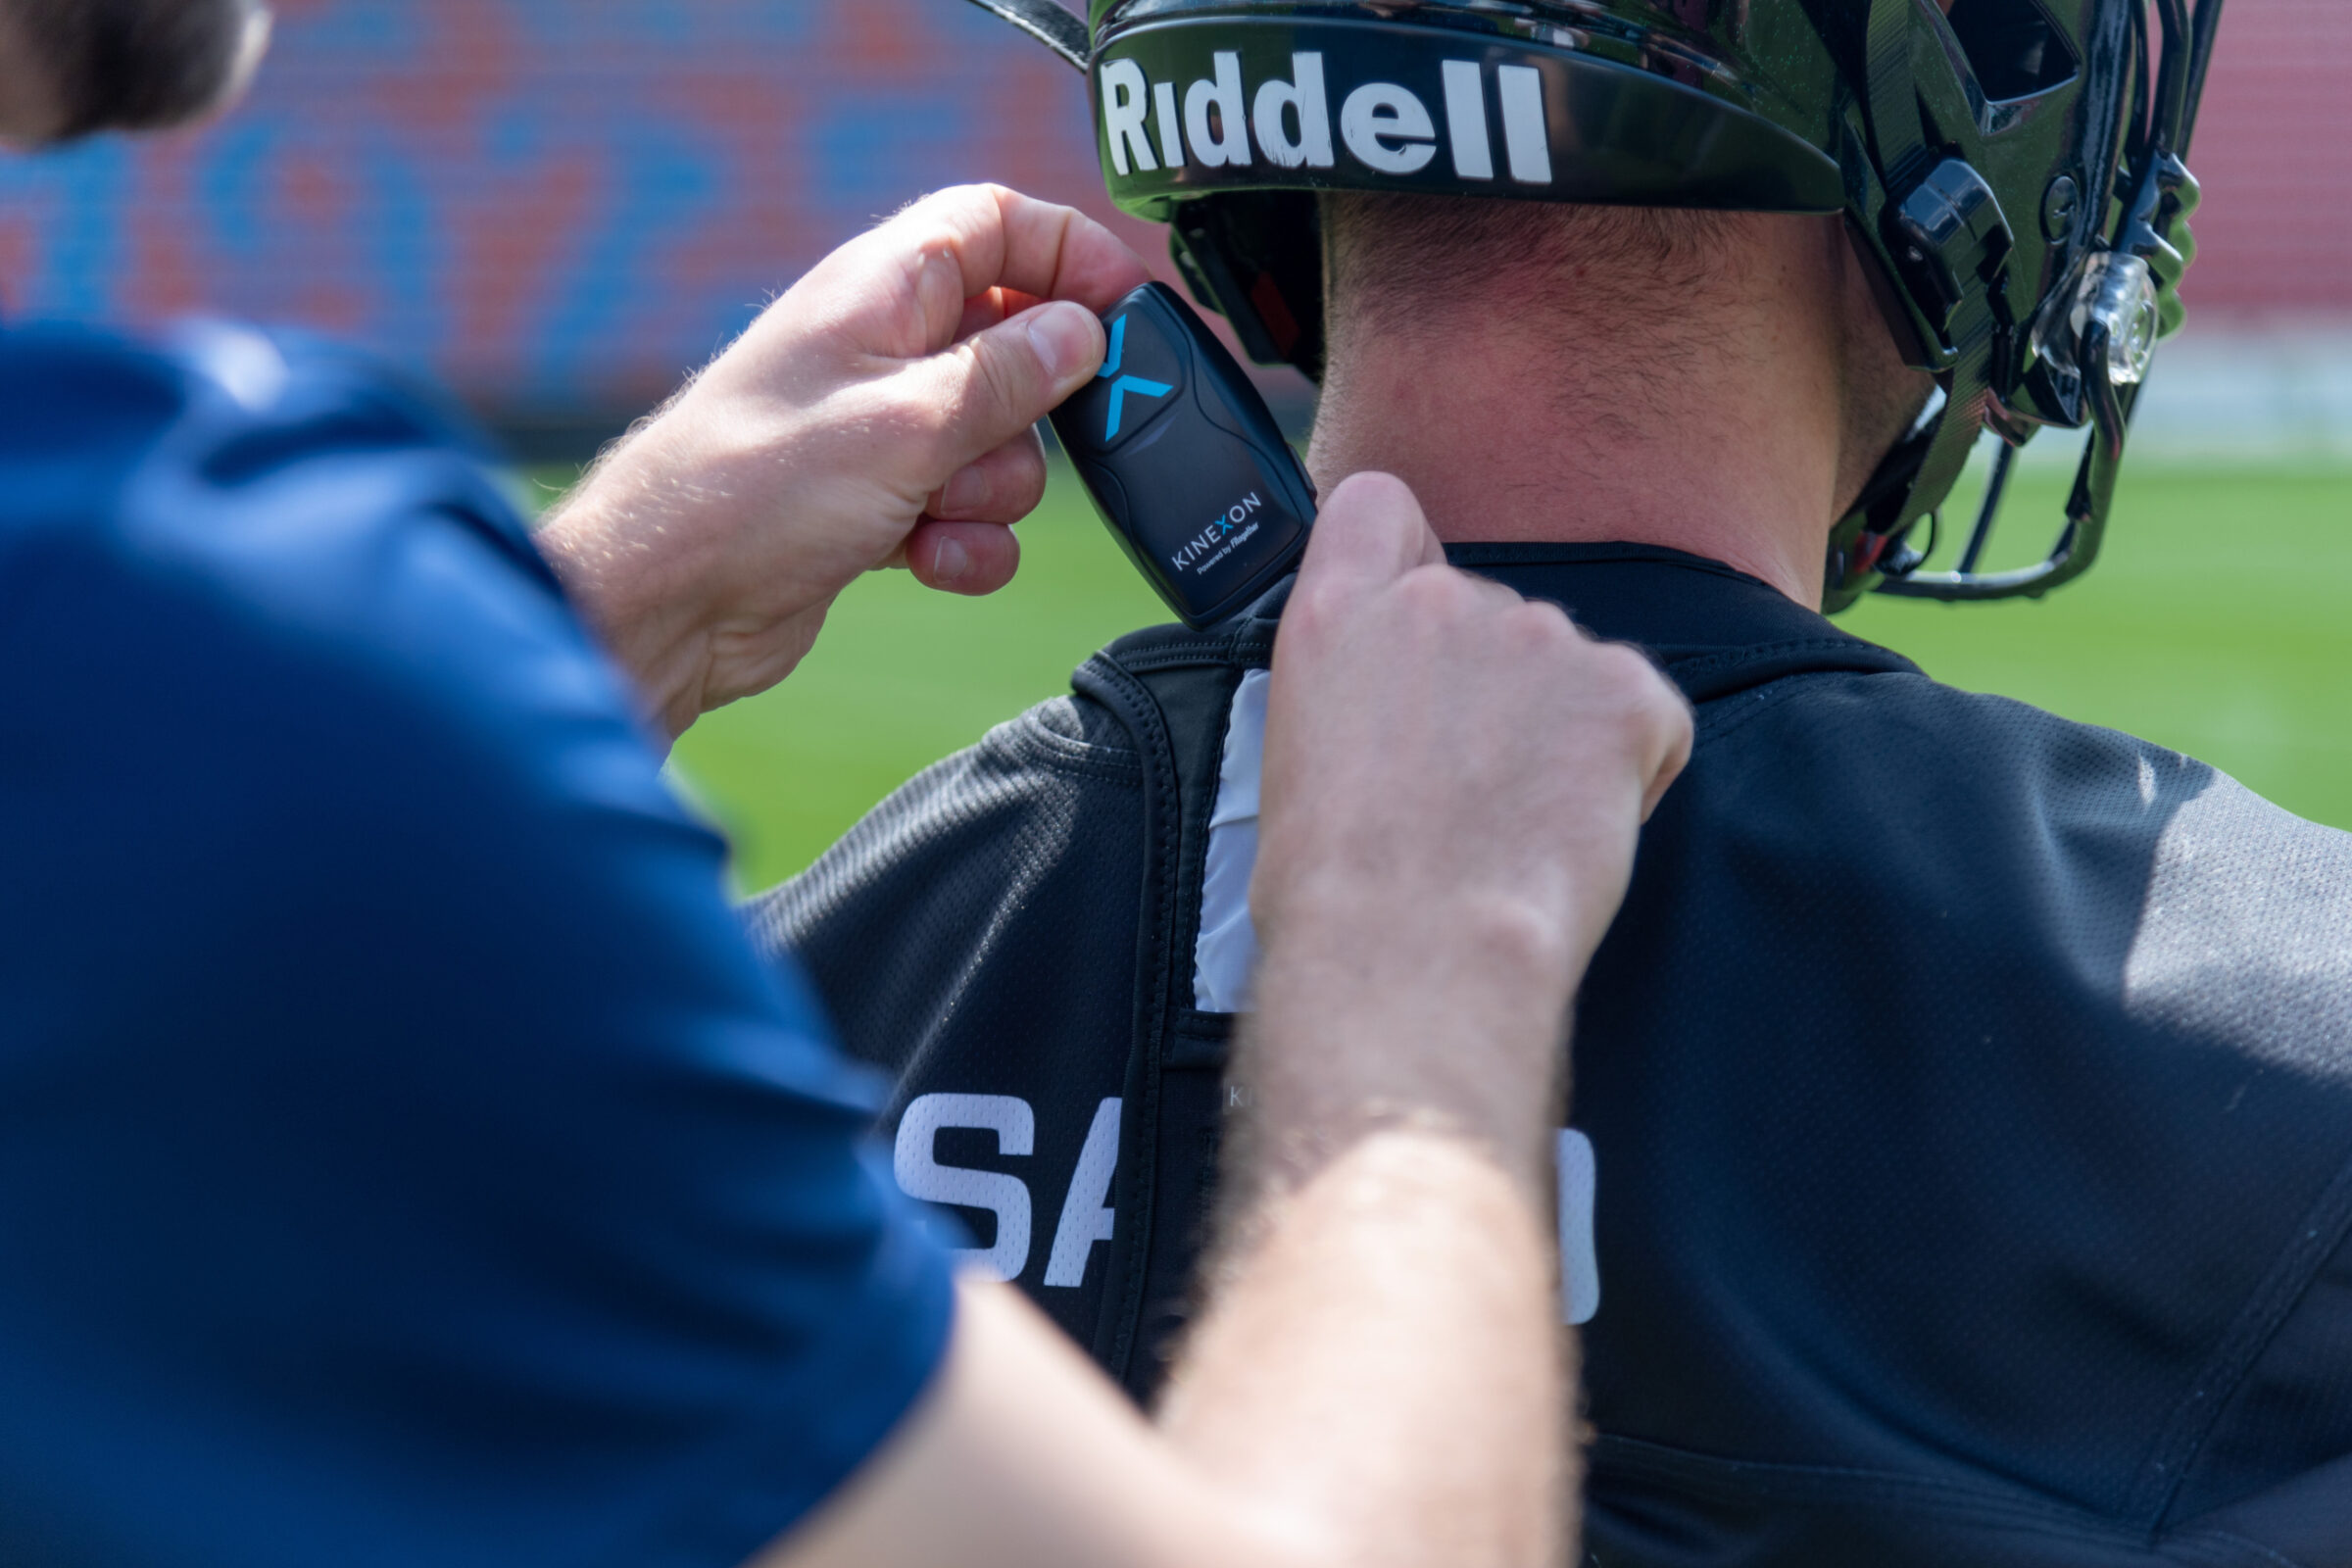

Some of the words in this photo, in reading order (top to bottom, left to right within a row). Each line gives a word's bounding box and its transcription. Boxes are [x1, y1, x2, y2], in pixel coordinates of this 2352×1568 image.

[1100, 50, 1552, 184] Riddell
[1171, 491, 1262, 571] KINEXON
[1196, 551, 1224, 575] Powered
[1221, 545, 1232, 556] by
